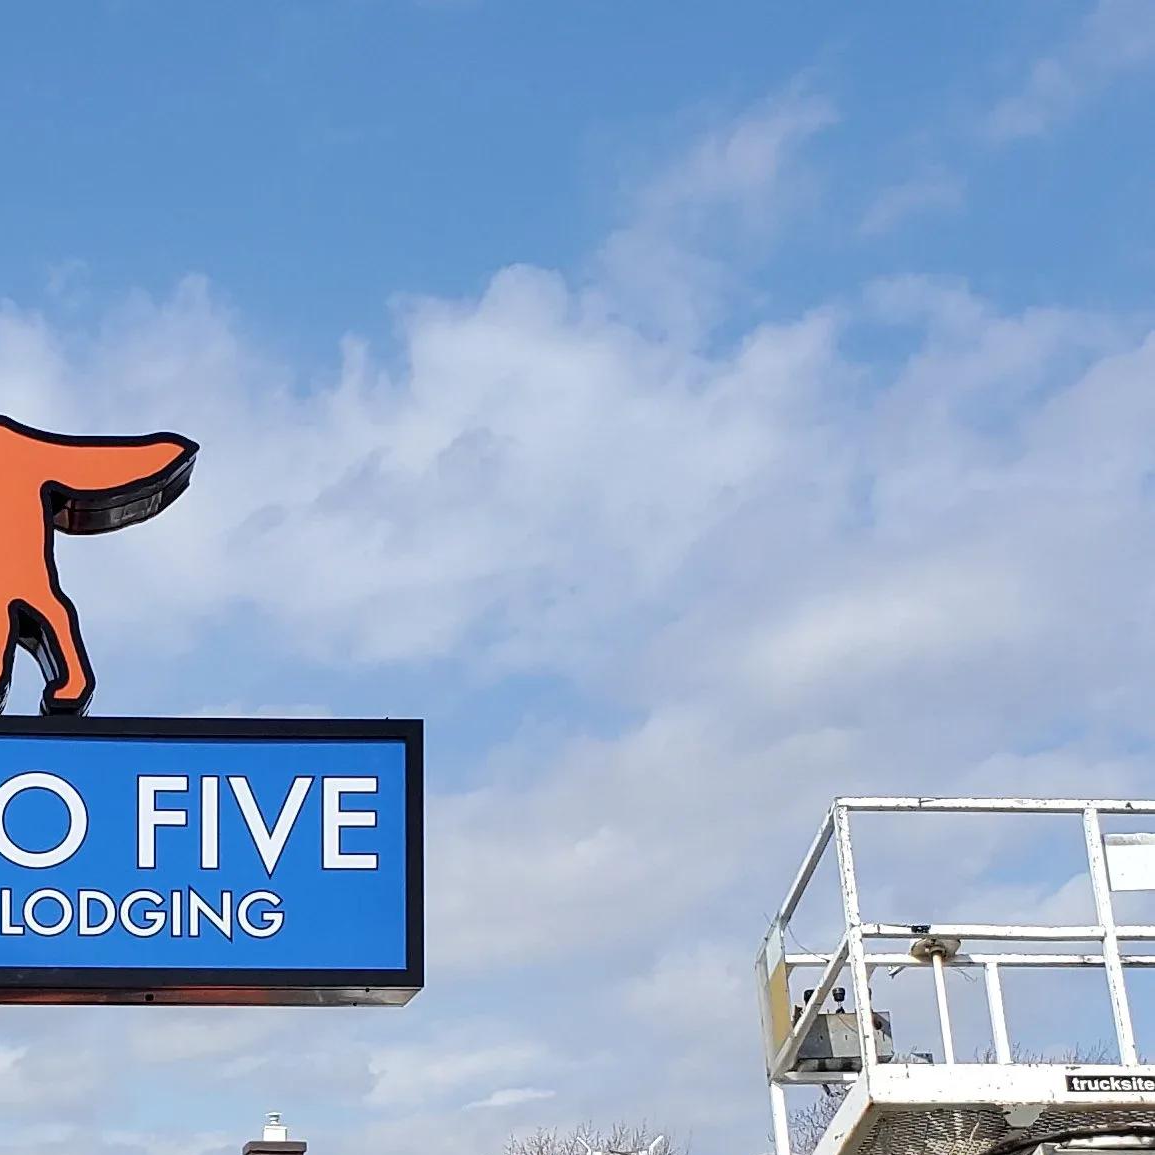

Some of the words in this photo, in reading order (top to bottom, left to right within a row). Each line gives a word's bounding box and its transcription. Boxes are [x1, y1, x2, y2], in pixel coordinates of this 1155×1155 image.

[138, 774, 378, 875] FIVE
[1, 889, 284, 938] LODGING
[1072, 1077, 1155, 1091] trucksite
